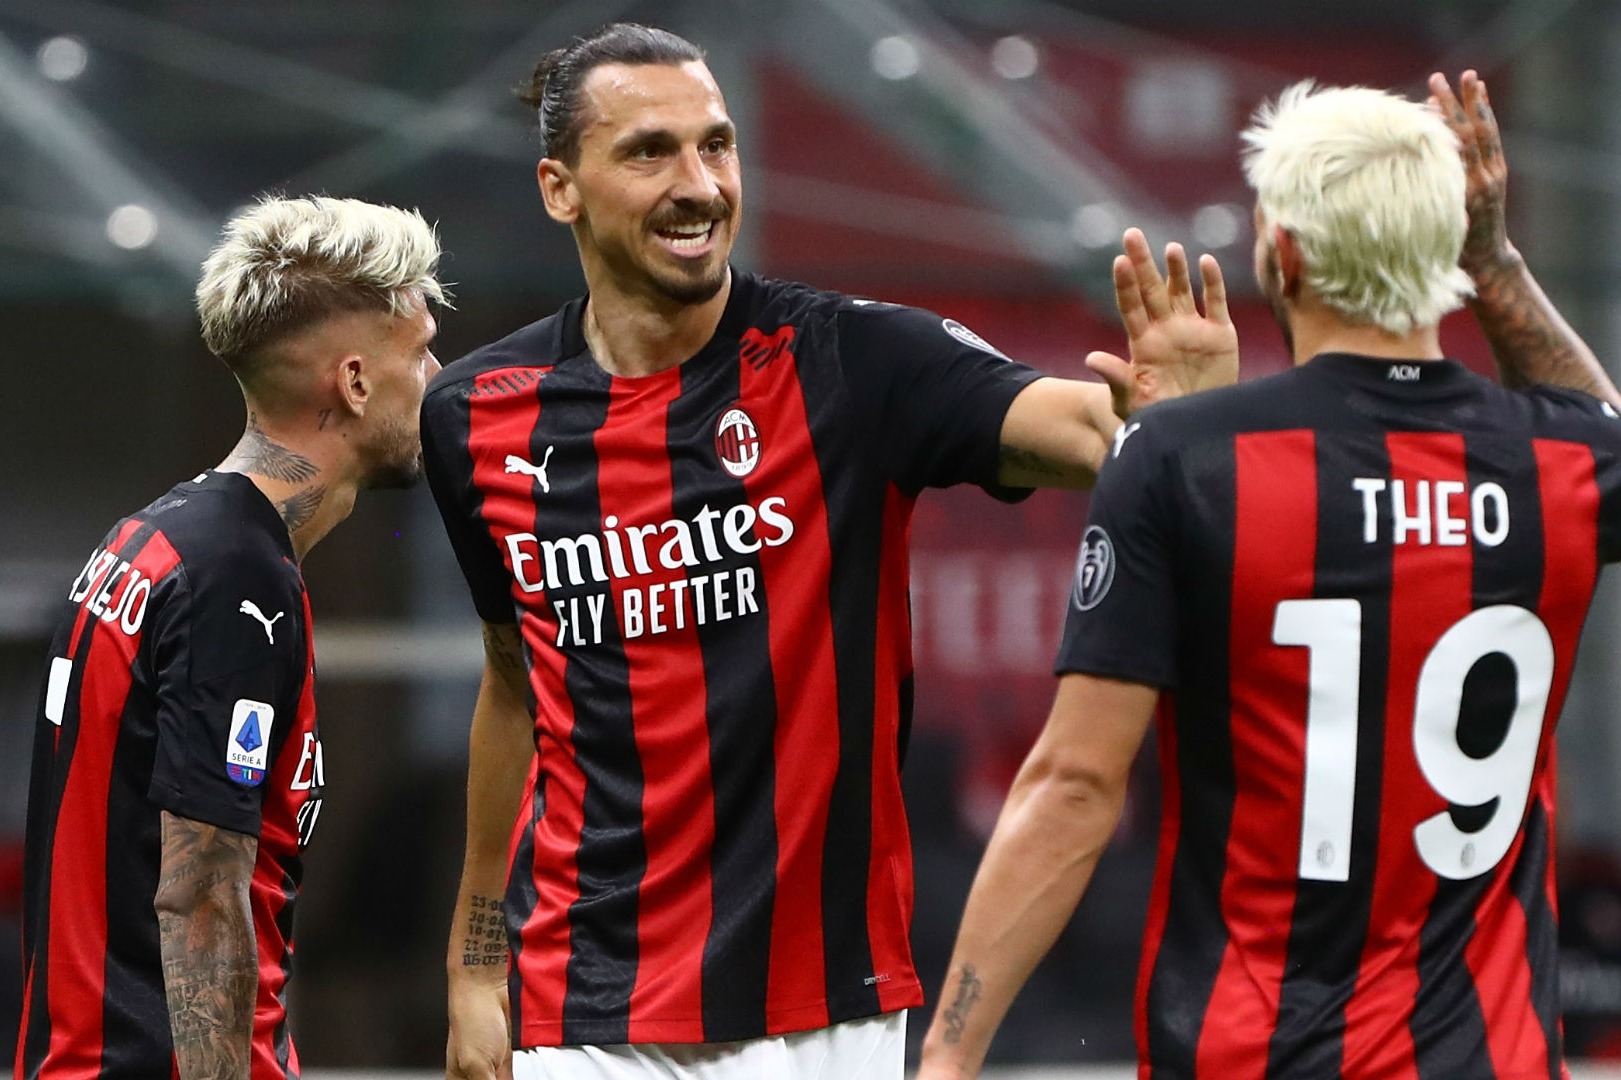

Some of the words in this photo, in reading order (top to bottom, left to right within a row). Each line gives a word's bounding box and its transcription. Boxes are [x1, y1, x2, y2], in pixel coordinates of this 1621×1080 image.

[1389, 364, 1421, 381] ACM
[723, 411, 748, 427] ACM
[504, 496, 794, 593] Emirates
[1352, 477, 1511, 547] THEO
[553, 593, 606, 648] FLY
[622, 566, 760, 639] BETTER
[232, 752, 254, 765] SERIE
[1272, 598, 1556, 882] 19
